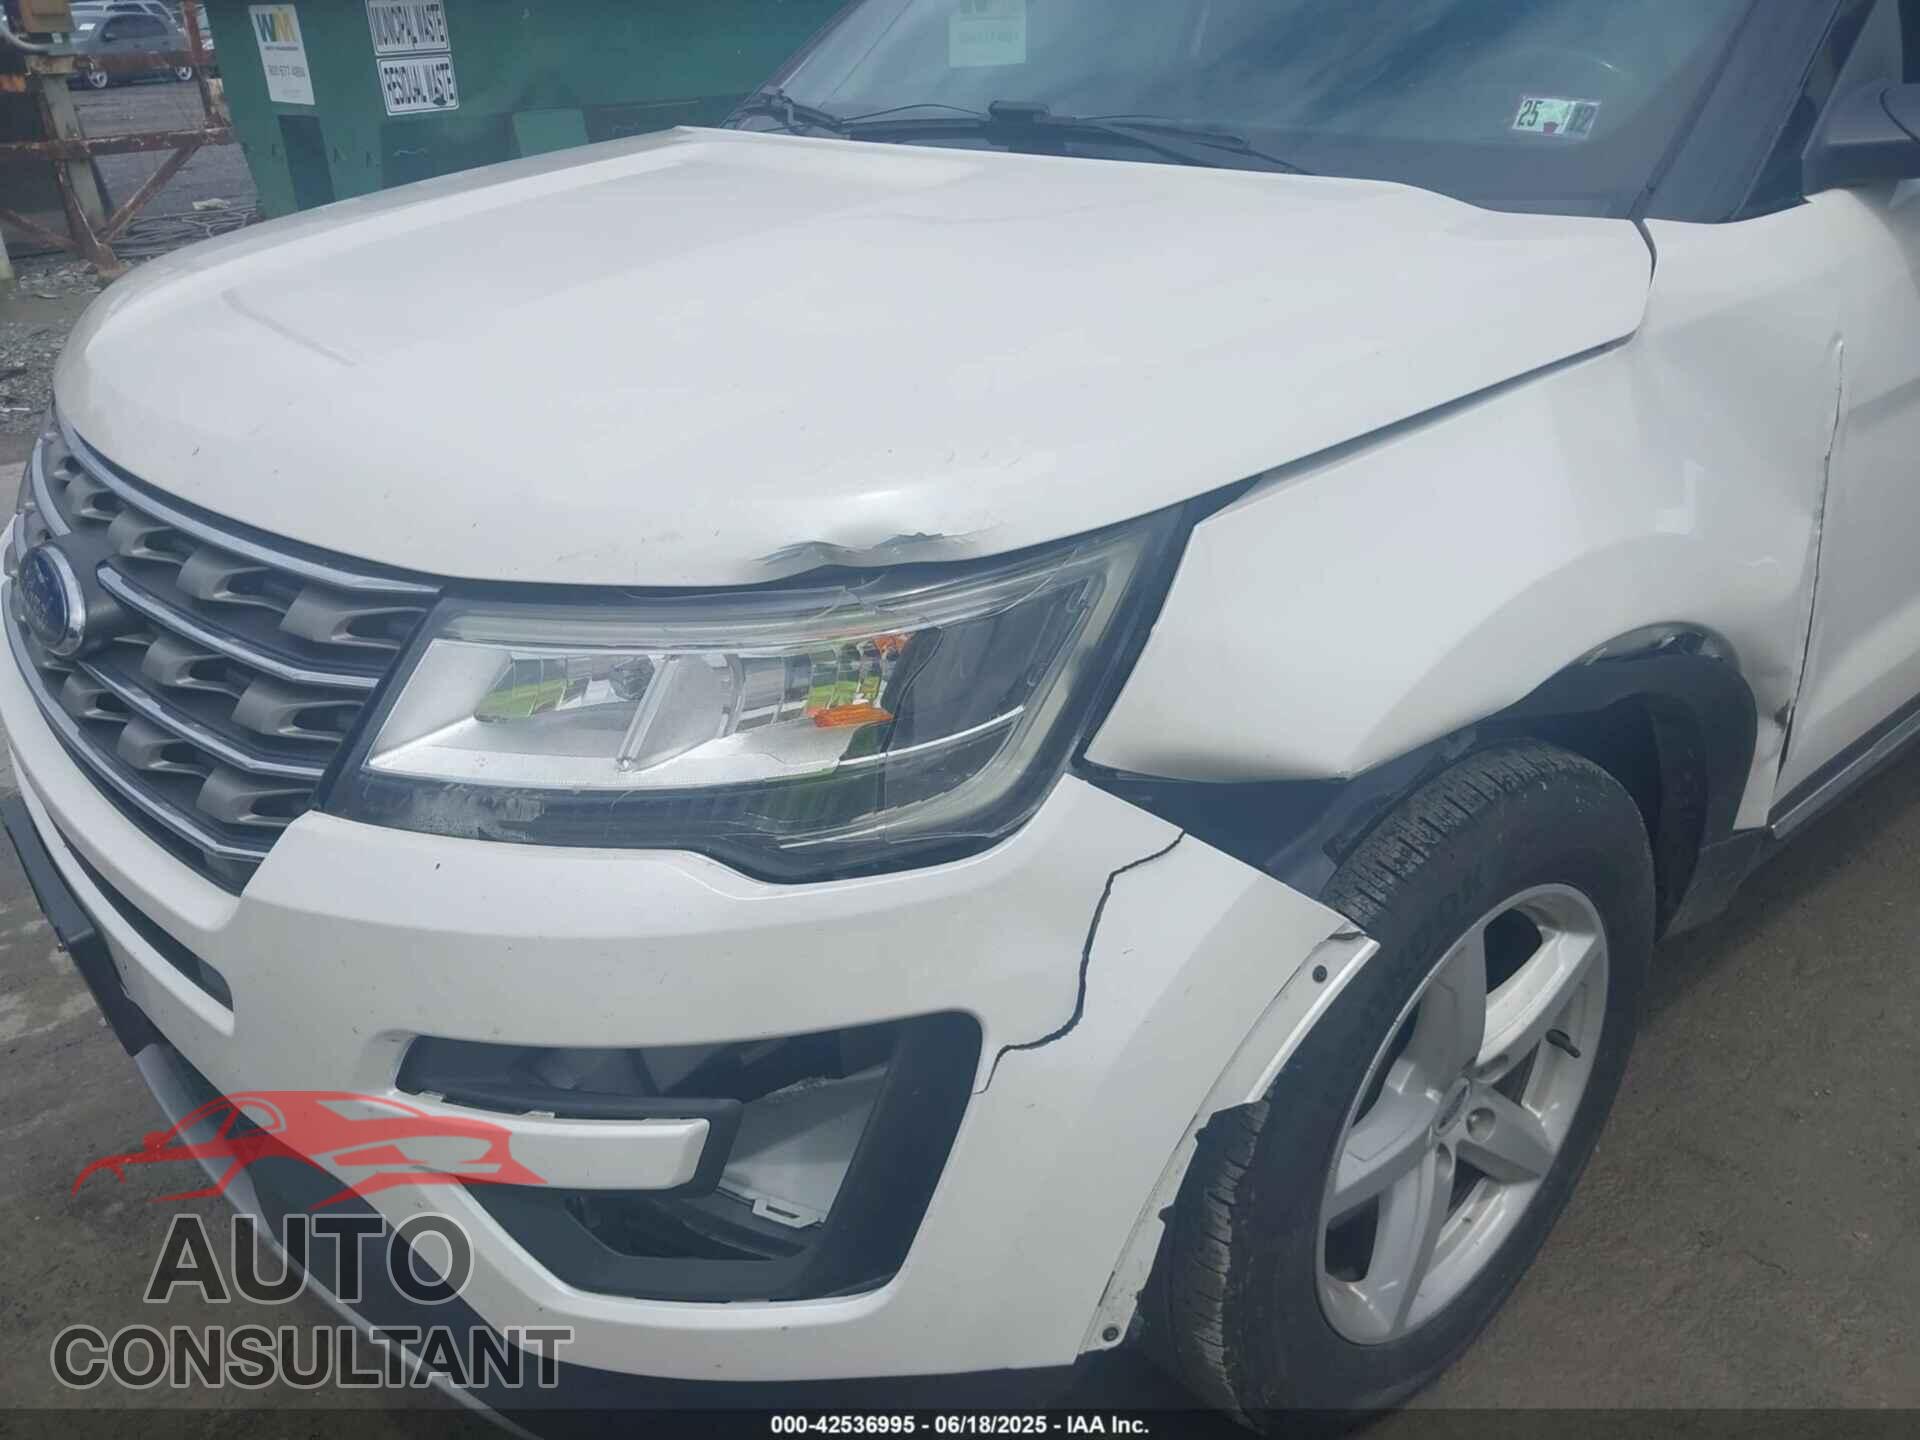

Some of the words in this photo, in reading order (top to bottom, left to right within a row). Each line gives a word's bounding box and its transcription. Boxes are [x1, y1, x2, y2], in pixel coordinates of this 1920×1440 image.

[255, 13, 297, 42] WM
[414, 4, 444, 43] WASTE
[383, 65, 427, 105] RESIDUAL
[422, 63, 455, 101] WASTE
[1517, 100, 1543, 127] 25
